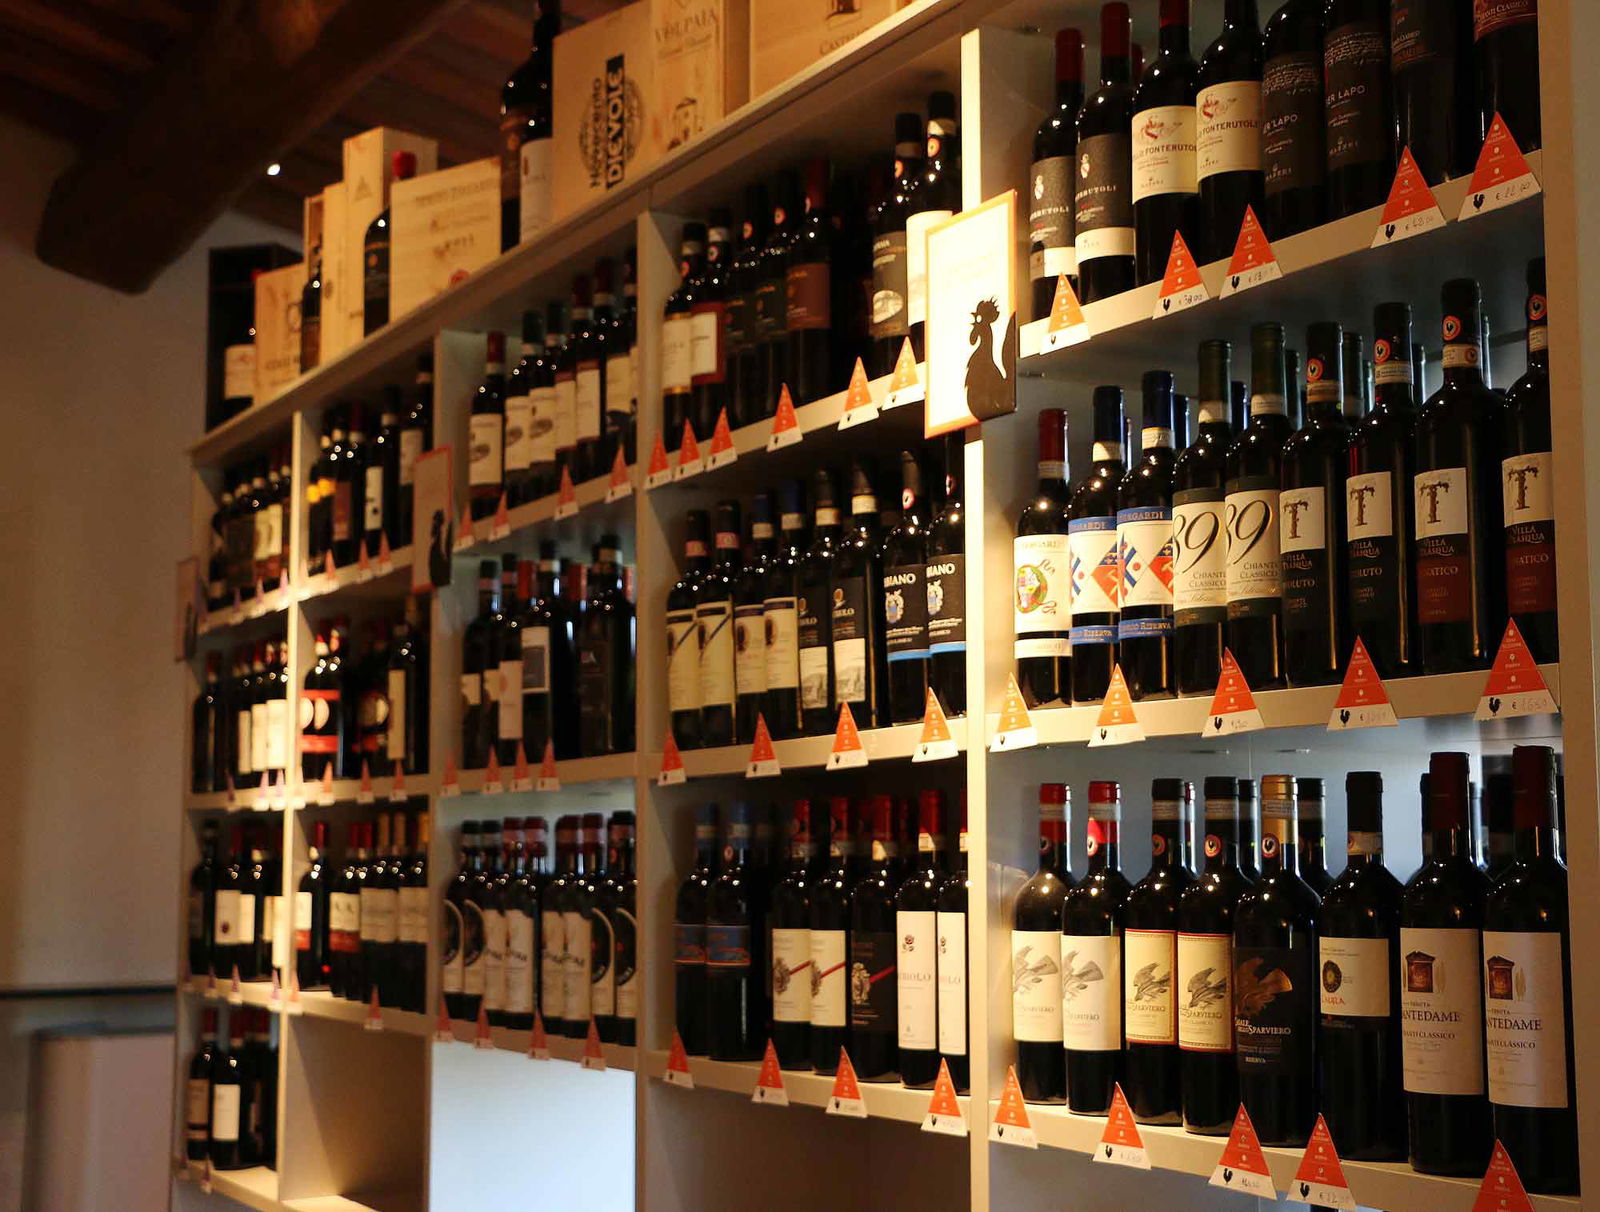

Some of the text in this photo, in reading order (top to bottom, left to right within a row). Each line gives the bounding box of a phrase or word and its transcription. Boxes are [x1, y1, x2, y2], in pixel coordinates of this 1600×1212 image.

[1339, 85, 1365, 98] LAPO
[1273, 114, 1298, 126] LAPO
[1249, 1025, 1291, 1035] SPARVIERO
